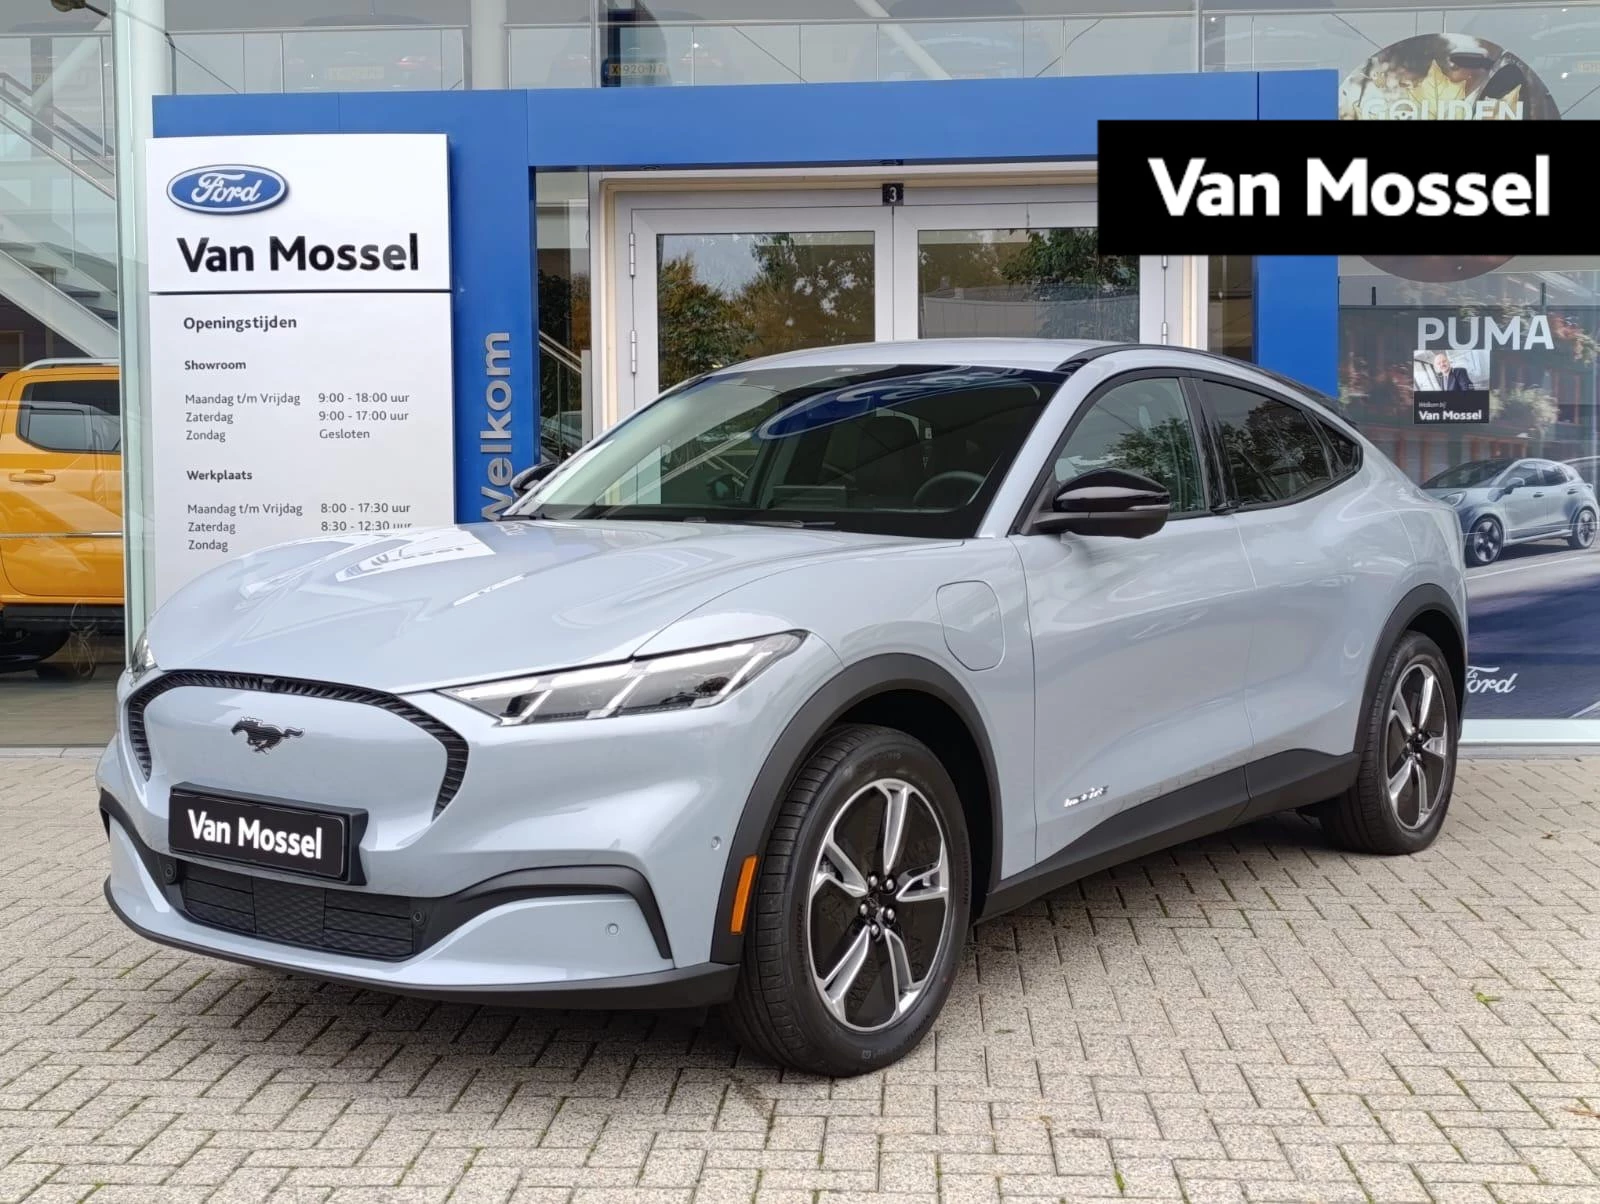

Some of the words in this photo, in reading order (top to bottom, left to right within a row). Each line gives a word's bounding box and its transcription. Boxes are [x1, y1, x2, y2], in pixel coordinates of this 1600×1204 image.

[190, 172, 263, 204] Ford
[888, 186, 898, 203] 3
[176, 236, 255, 272] Van
[269, 233, 419, 272] Mossel
[183, 315, 298, 333] Openingstijden
[1417, 315, 1555, 350] PUMA
[184, 360, 247, 371] Showroom
[185, 394, 234, 407] Maandag
[237, 393, 257, 404] t/m
[260, 392, 301, 406] Vrijdag
[318, 392, 345, 403] 9:00
[355, 392, 388, 403] 18:00
[390, 394, 410, 403] uur
[185, 412, 234, 425] Zaterdag
[318, 410, 345, 421] 9:00
[355, 410, 387, 421] 17:00
[390, 412, 409, 421] uur
[1418, 410, 1440, 420] Van
[1442, 409, 1482, 420] Mossel
[186, 429, 226, 443] Zondag
[319, 428, 371, 439] Gesloten
[186, 470, 253, 483] Werkplaats
[187, 504, 237, 517] Maandag
[239, 503, 260, 514] t/m
[262, 503, 303, 516] Vrijdag
[320, 502, 347, 513] 8:00
[358, 502, 389, 513] 17:30
[391, 504, 411, 513] uur
[188, 522, 236, 535] Zaterdag
[320, 521, 347, 531] 8:30
[358, 520, 390, 531] 12:30
[188, 539, 228, 552] Zondag
[187, 808, 231, 844] Van
[237, 816, 323, 860] Mossel
